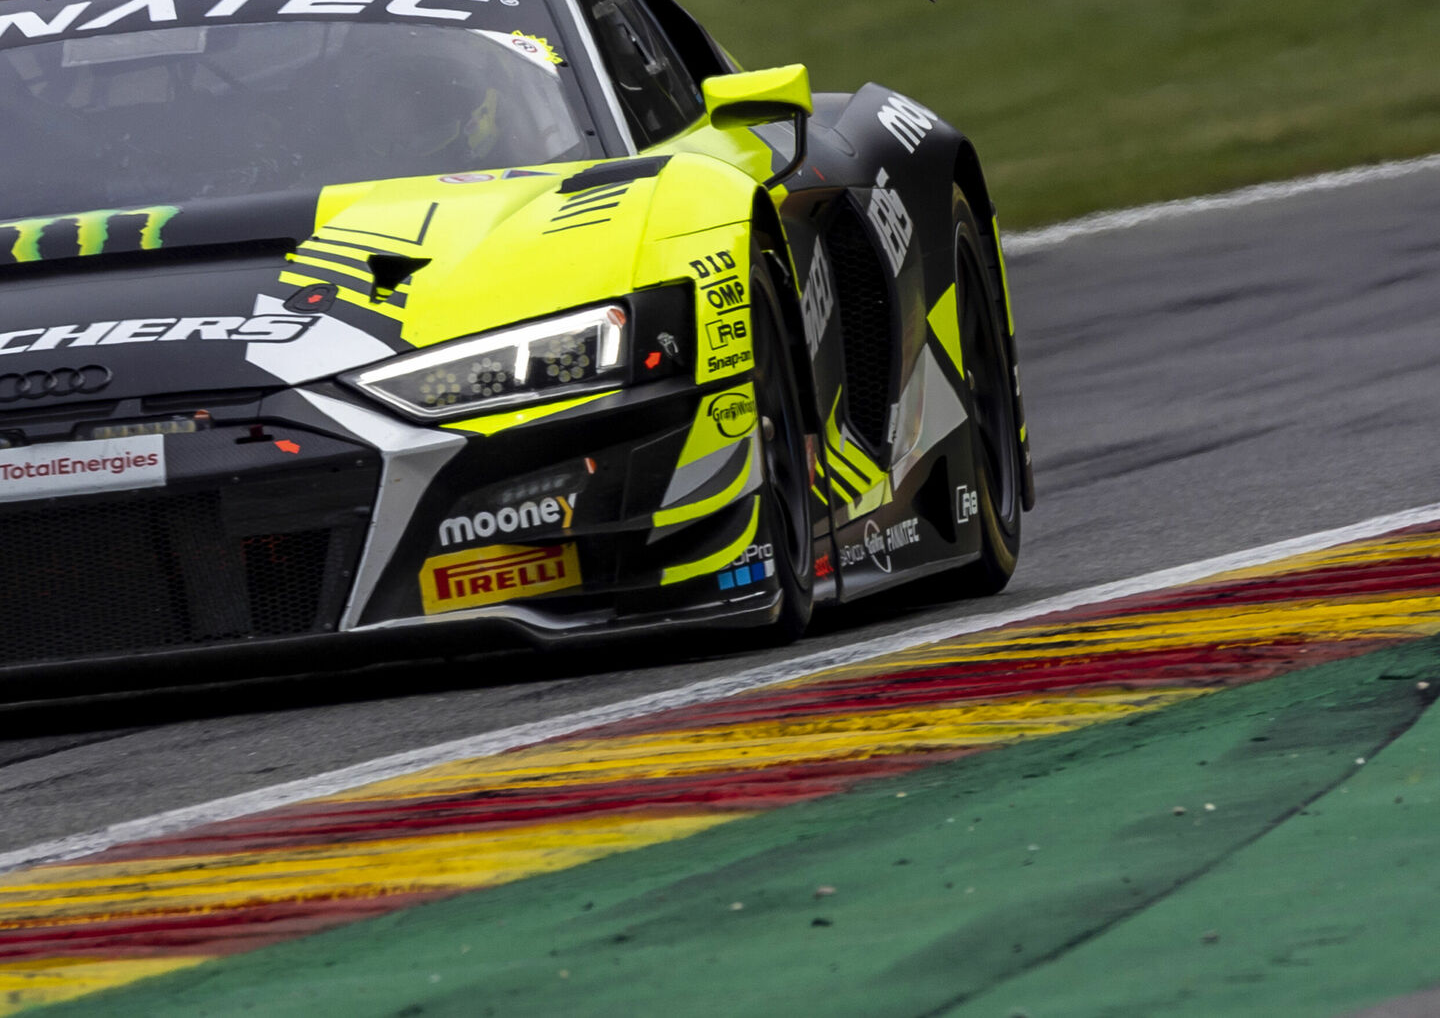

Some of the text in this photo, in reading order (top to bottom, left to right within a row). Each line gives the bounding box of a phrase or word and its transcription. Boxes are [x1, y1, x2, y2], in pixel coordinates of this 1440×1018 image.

[707, 282, 745, 308] OMP
[715, 321, 747, 344] R8
[439, 493, 577, 547] mooney
[720, 543, 773, 571] oPro
[433, 546, 566, 601] PIRELLI
